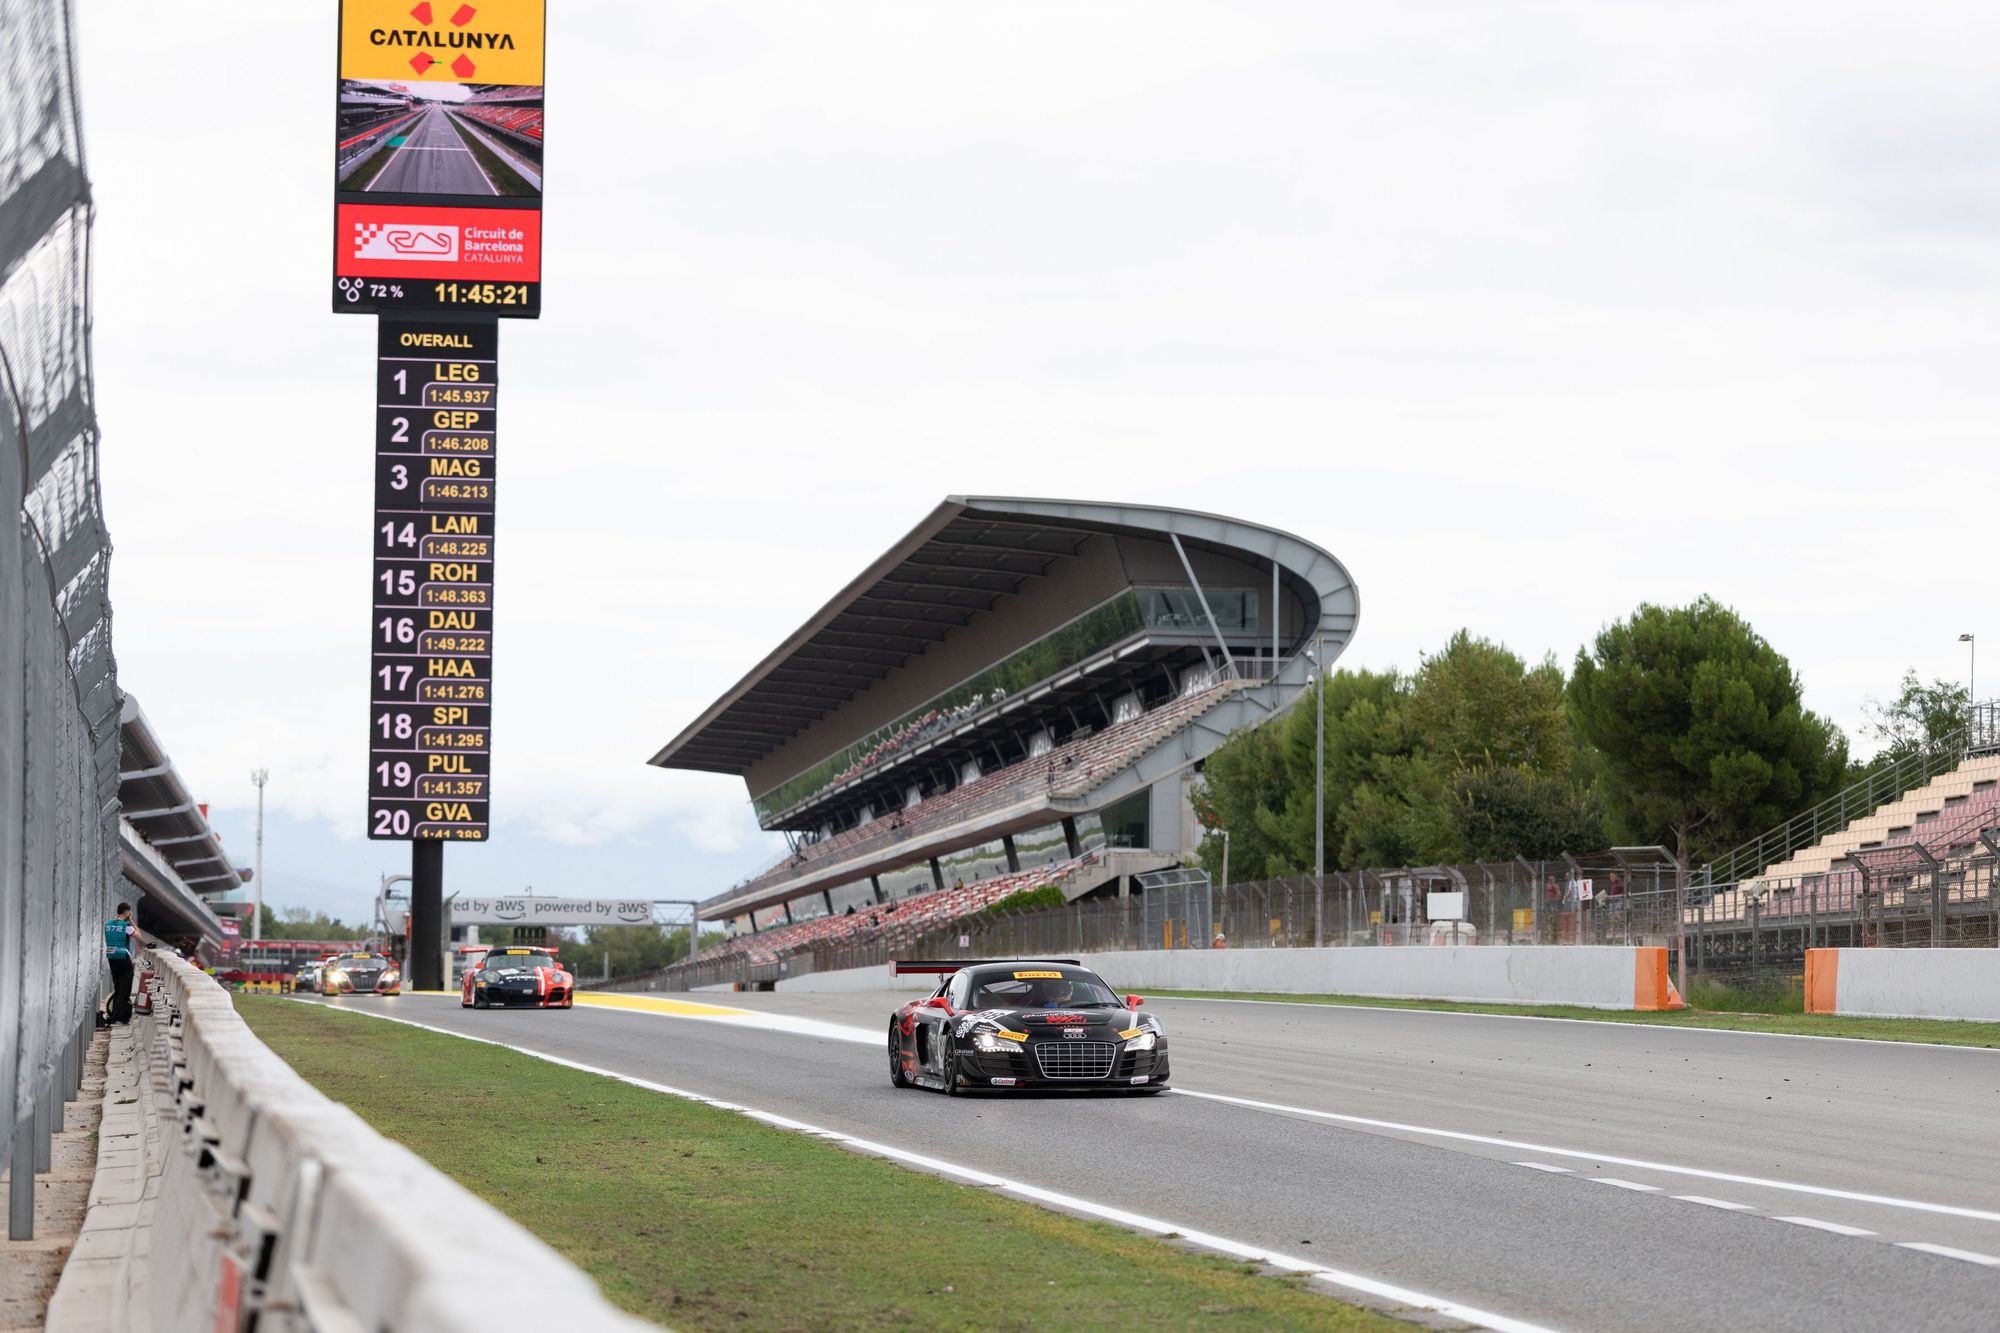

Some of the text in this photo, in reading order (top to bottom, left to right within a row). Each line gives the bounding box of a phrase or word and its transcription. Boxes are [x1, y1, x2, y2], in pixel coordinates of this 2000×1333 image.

[370, 29, 515, 50] CATALUNYA
[464, 227, 524, 240] Circuit de
[464, 240, 524, 253] Barcelona
[464, 253, 524, 264] CATALUNYA
[370, 284, 387, 298] 72
[435, 283, 528, 305] 11:45:21
[400, 333, 473, 348] OVERALL
[435, 363, 480, 382] LEG
[393, 369, 407, 396] 1
[430, 389, 490, 404] 1:45.937
[391, 416, 410, 443] 2
[433, 411, 480, 429] GEP
[429, 437, 489, 451] 1:46.208
[430, 458, 481, 477] MAG
[390, 464, 409, 491] 3
[428, 484, 488, 498] 1:46.213
[431, 515, 478, 534] LAM
[381, 521, 417, 548] 14
[427, 541, 488, 556] 1:48.225
[429, 563, 478, 582] ROH
[380, 569, 416, 596] 15
[426, 589, 486, 604] 1:48.363
[429, 610, 476, 630] DAU
[379, 616, 415, 644] 16
[425, 637, 485, 652] 1:49.222
[428, 658, 476, 677] HAA
[378, 664, 414, 692] 17
[424, 685, 485, 699] 1:41.276
[433, 706, 468, 725] SPI
[377, 712, 413, 740] 18
[423, 733, 484, 747] 1:41.295
[428, 754, 472, 773] PUL
[376, 760, 412, 788] 19
[422, 781, 483, 795] 1:41.357
[426, 802, 472, 821] GVA
[373, 808, 411, 836] 20
[473, 900, 489, 915] by
[495, 900, 526, 912] aws
[534, 901, 649, 917] powered by aws
